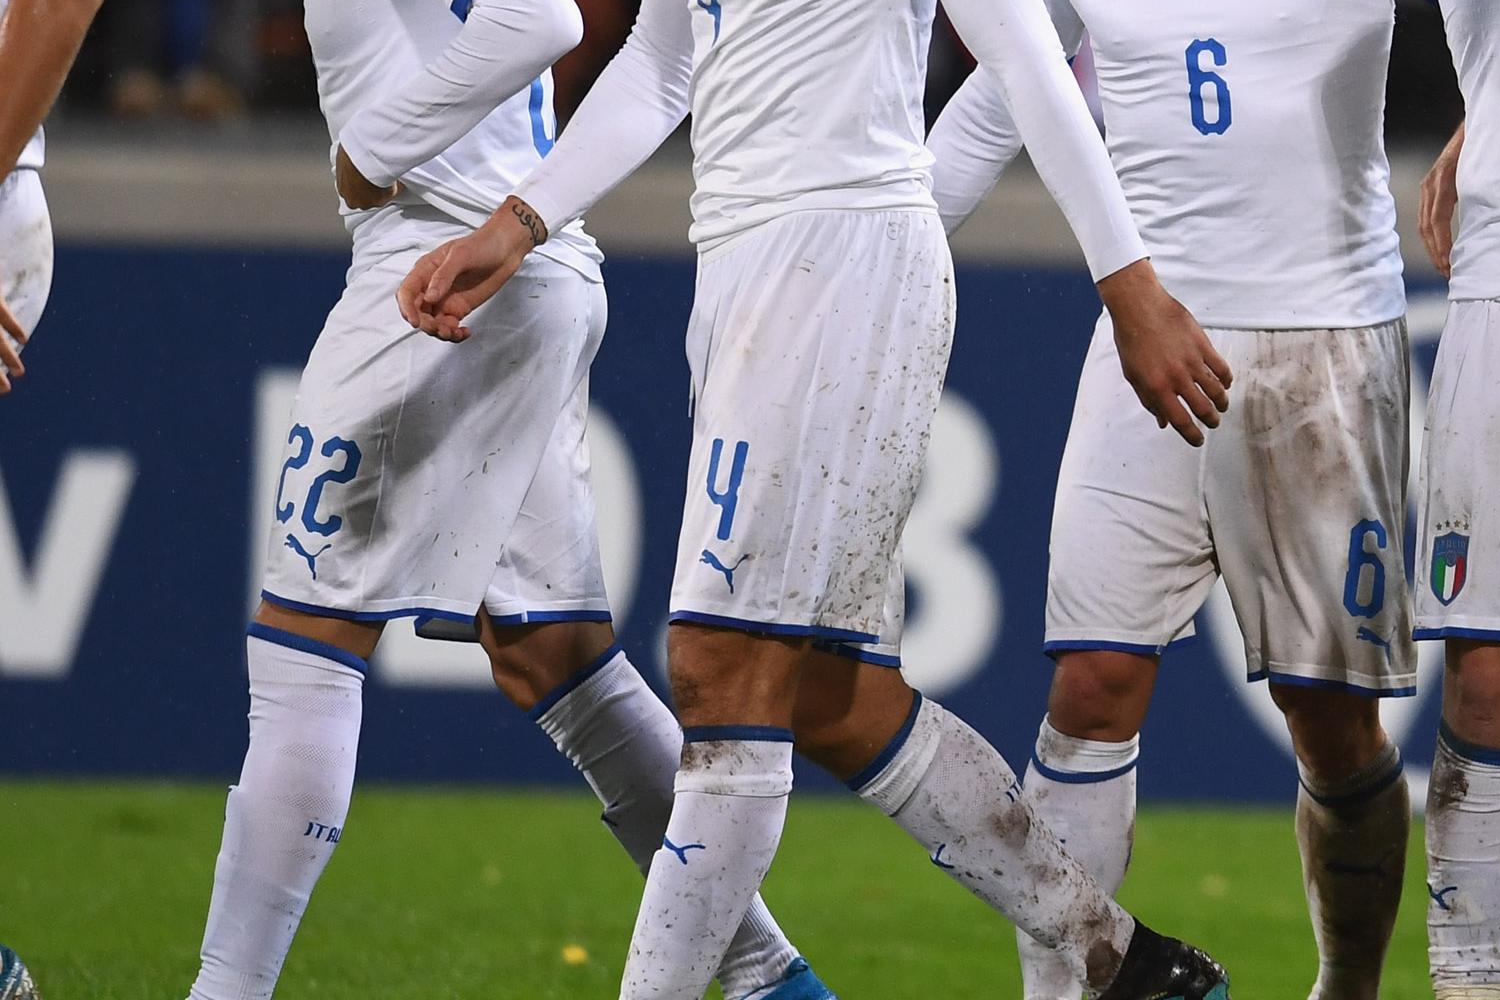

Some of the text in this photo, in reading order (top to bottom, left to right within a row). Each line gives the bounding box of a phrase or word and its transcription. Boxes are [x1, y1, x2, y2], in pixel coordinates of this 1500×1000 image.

[1185, 38, 1233, 136] 6
[275, 422, 362, 538] 22
[706, 438, 750, 541] 4
[1343, 518, 1388, 619] 6
